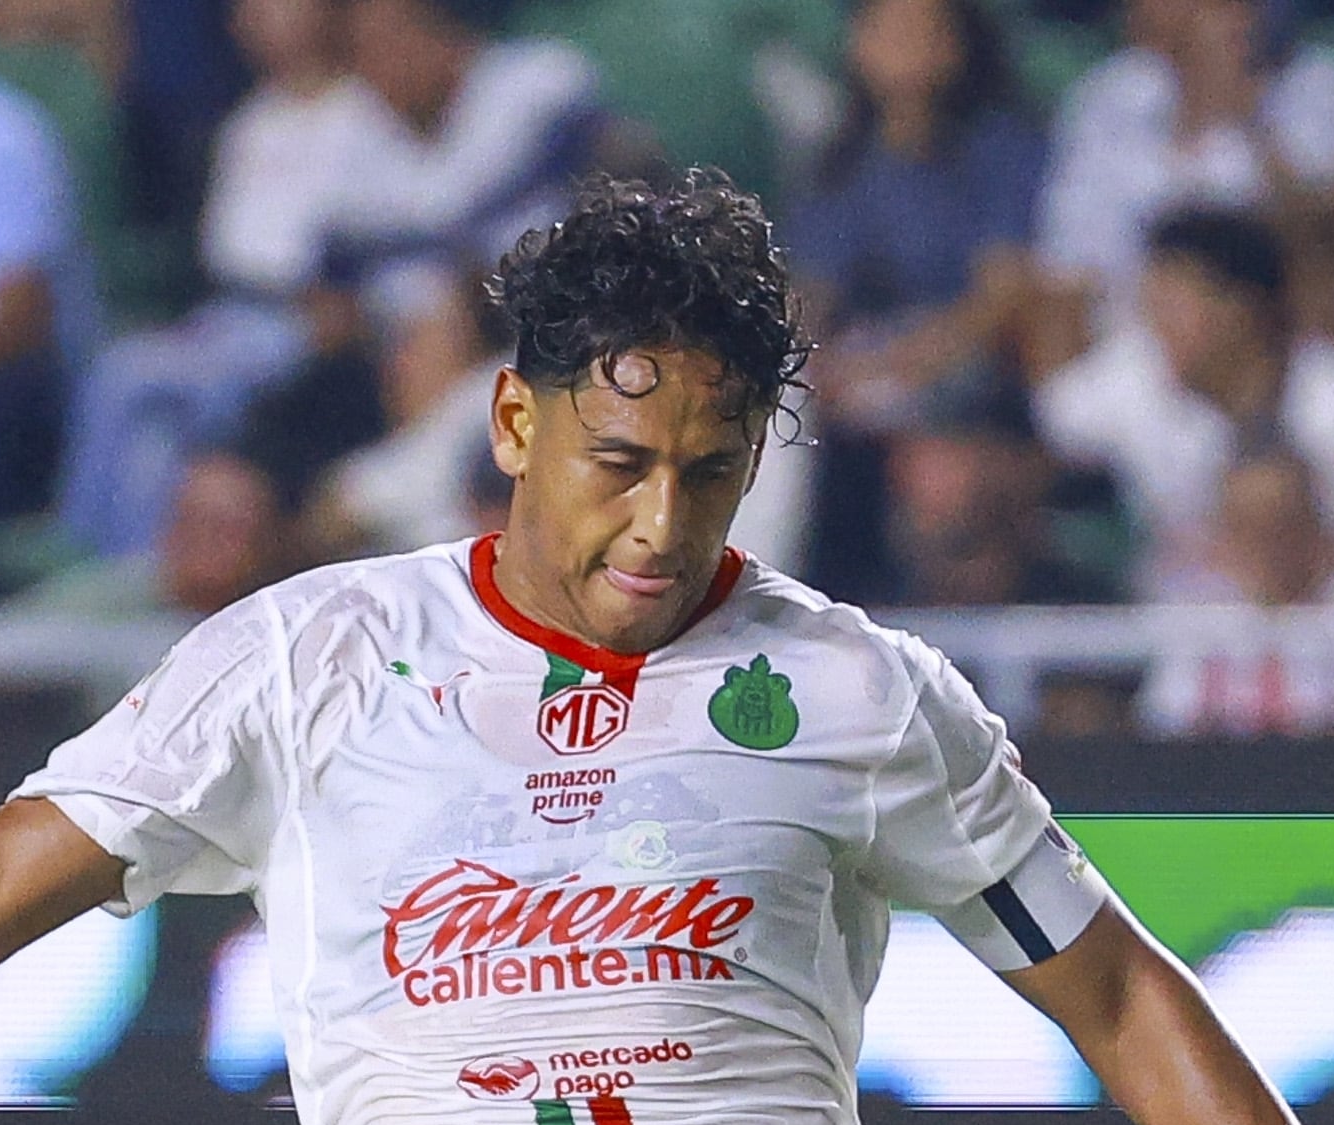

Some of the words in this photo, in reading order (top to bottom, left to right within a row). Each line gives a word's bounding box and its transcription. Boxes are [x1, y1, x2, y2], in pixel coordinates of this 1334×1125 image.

[543, 692, 623, 749] MG
[524, 766, 616, 790] amazon
[532, 787, 603, 814] prime
[379, 857, 755, 980] Caliente
[403, 945, 736, 1007] caliente.mx
[548, 1038, 693, 1072] mercado
[554, 1070, 635, 1100] pago
